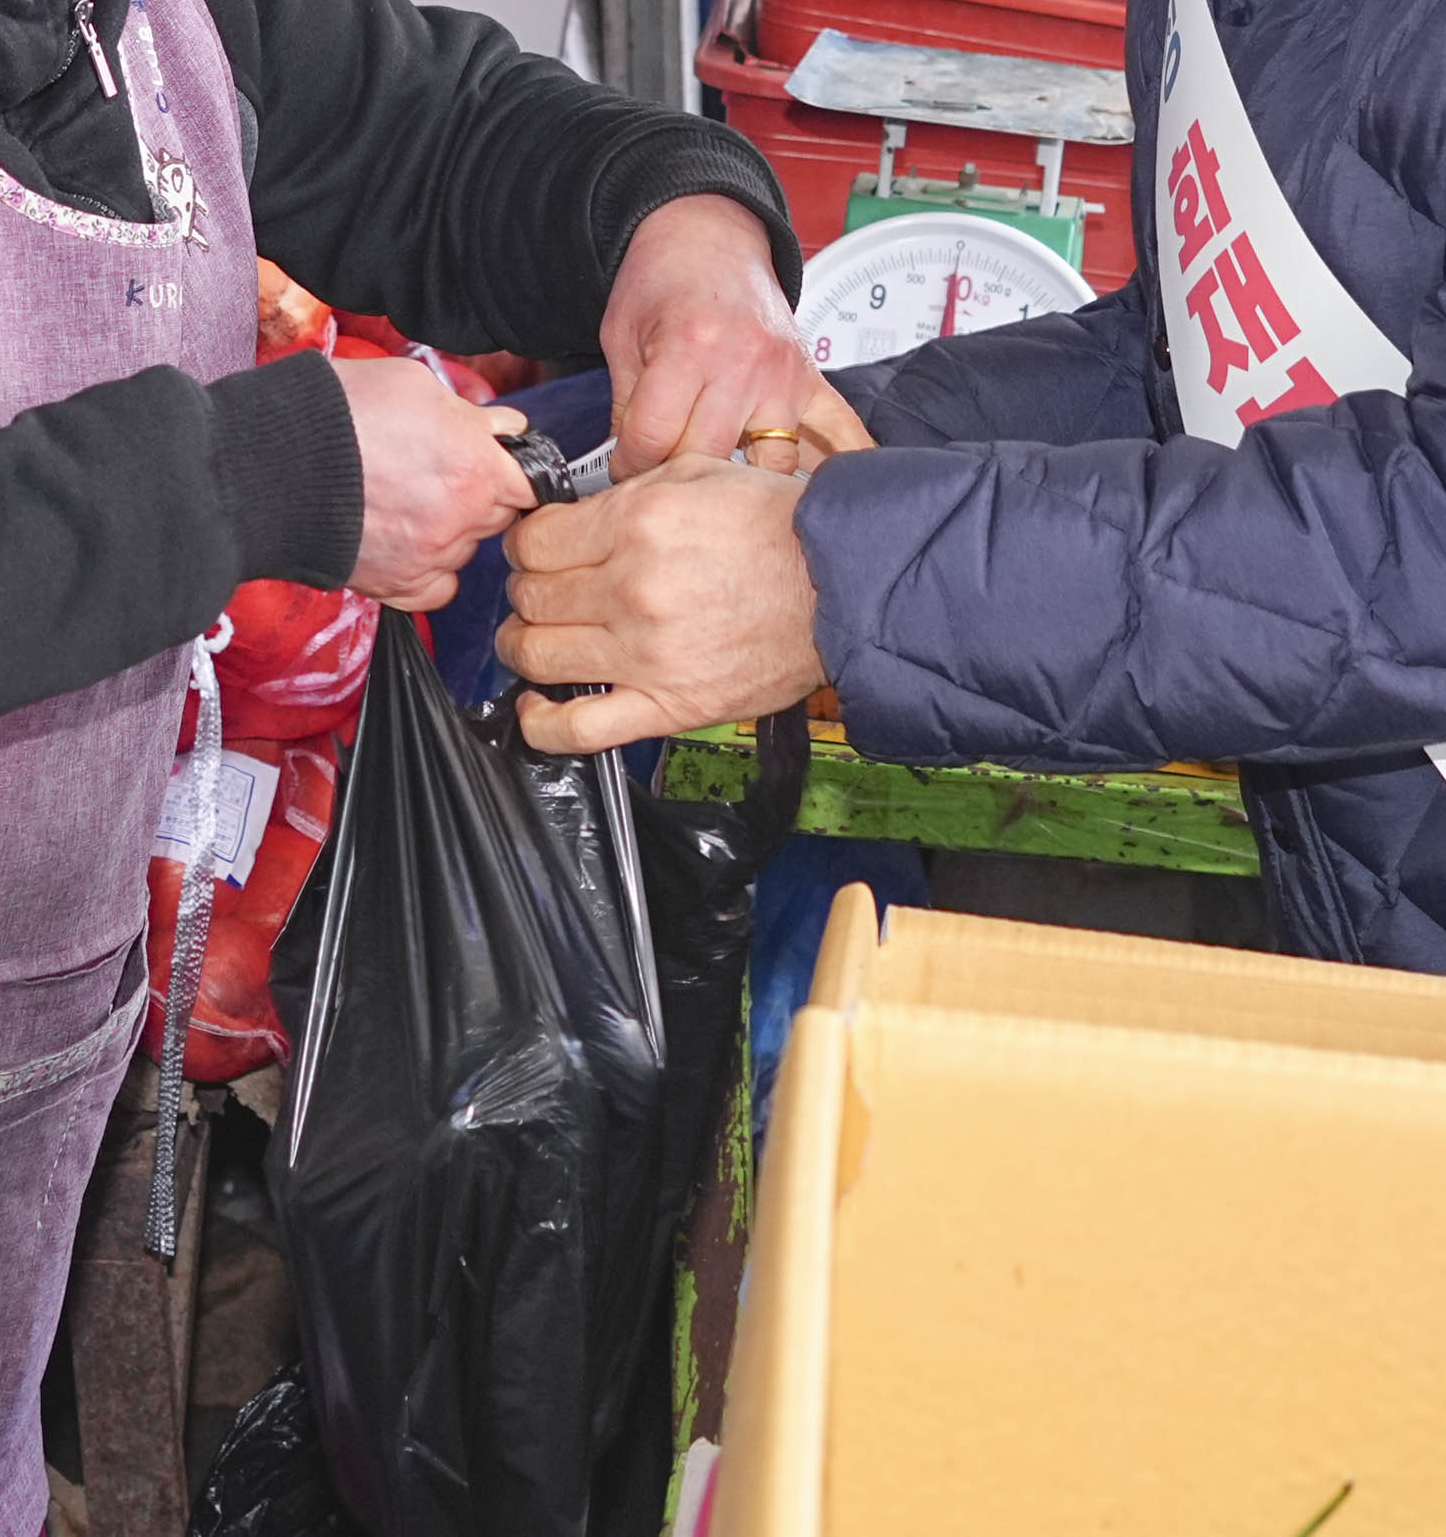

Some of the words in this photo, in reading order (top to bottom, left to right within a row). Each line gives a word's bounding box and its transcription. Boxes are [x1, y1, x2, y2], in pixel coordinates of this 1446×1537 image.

[905, 273, 926, 285] 500
[943, 273, 972, 302] 10
[869, 284, 887, 310] 9
[838, 311, 858, 323] 500
[814, 337, 831, 362] 8
